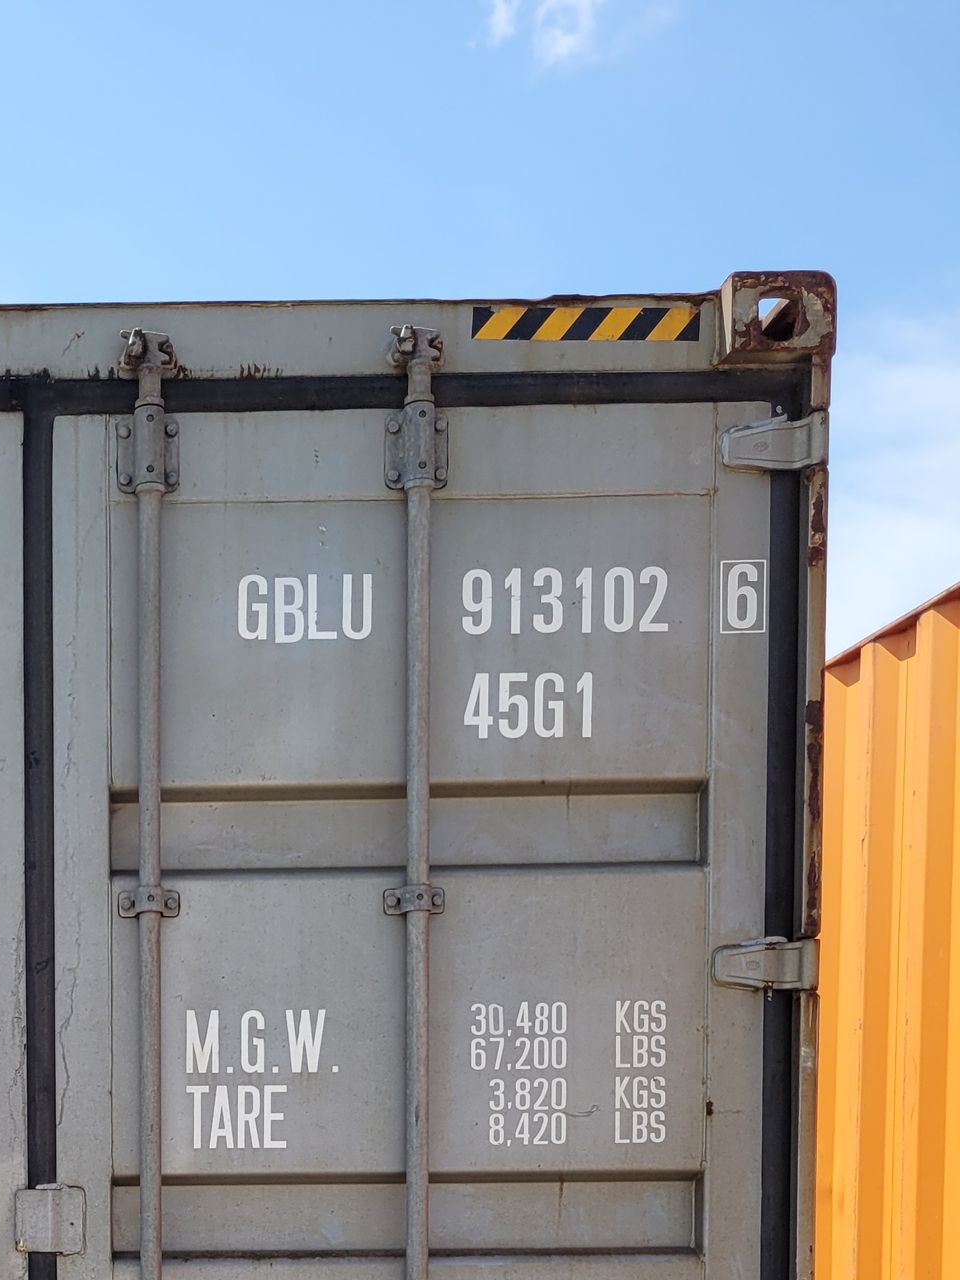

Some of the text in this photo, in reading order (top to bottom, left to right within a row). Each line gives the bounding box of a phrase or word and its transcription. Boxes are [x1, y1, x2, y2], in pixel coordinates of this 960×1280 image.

[237, 565, 760, 644] GBLU 913102 6
[463, 671, 594, 739] 45G1
[185, 1009, 340, 1074] M.G.W.
[470, 1000, 667, 1036] 30,480 KGS
[470, 1035, 667, 1071] 67,200 LBS
[186, 1084, 288, 1149] TARE
[489, 1075, 667, 1111] 3,820 KGS
[489, 1110, 667, 1147] 8,420 LBS
